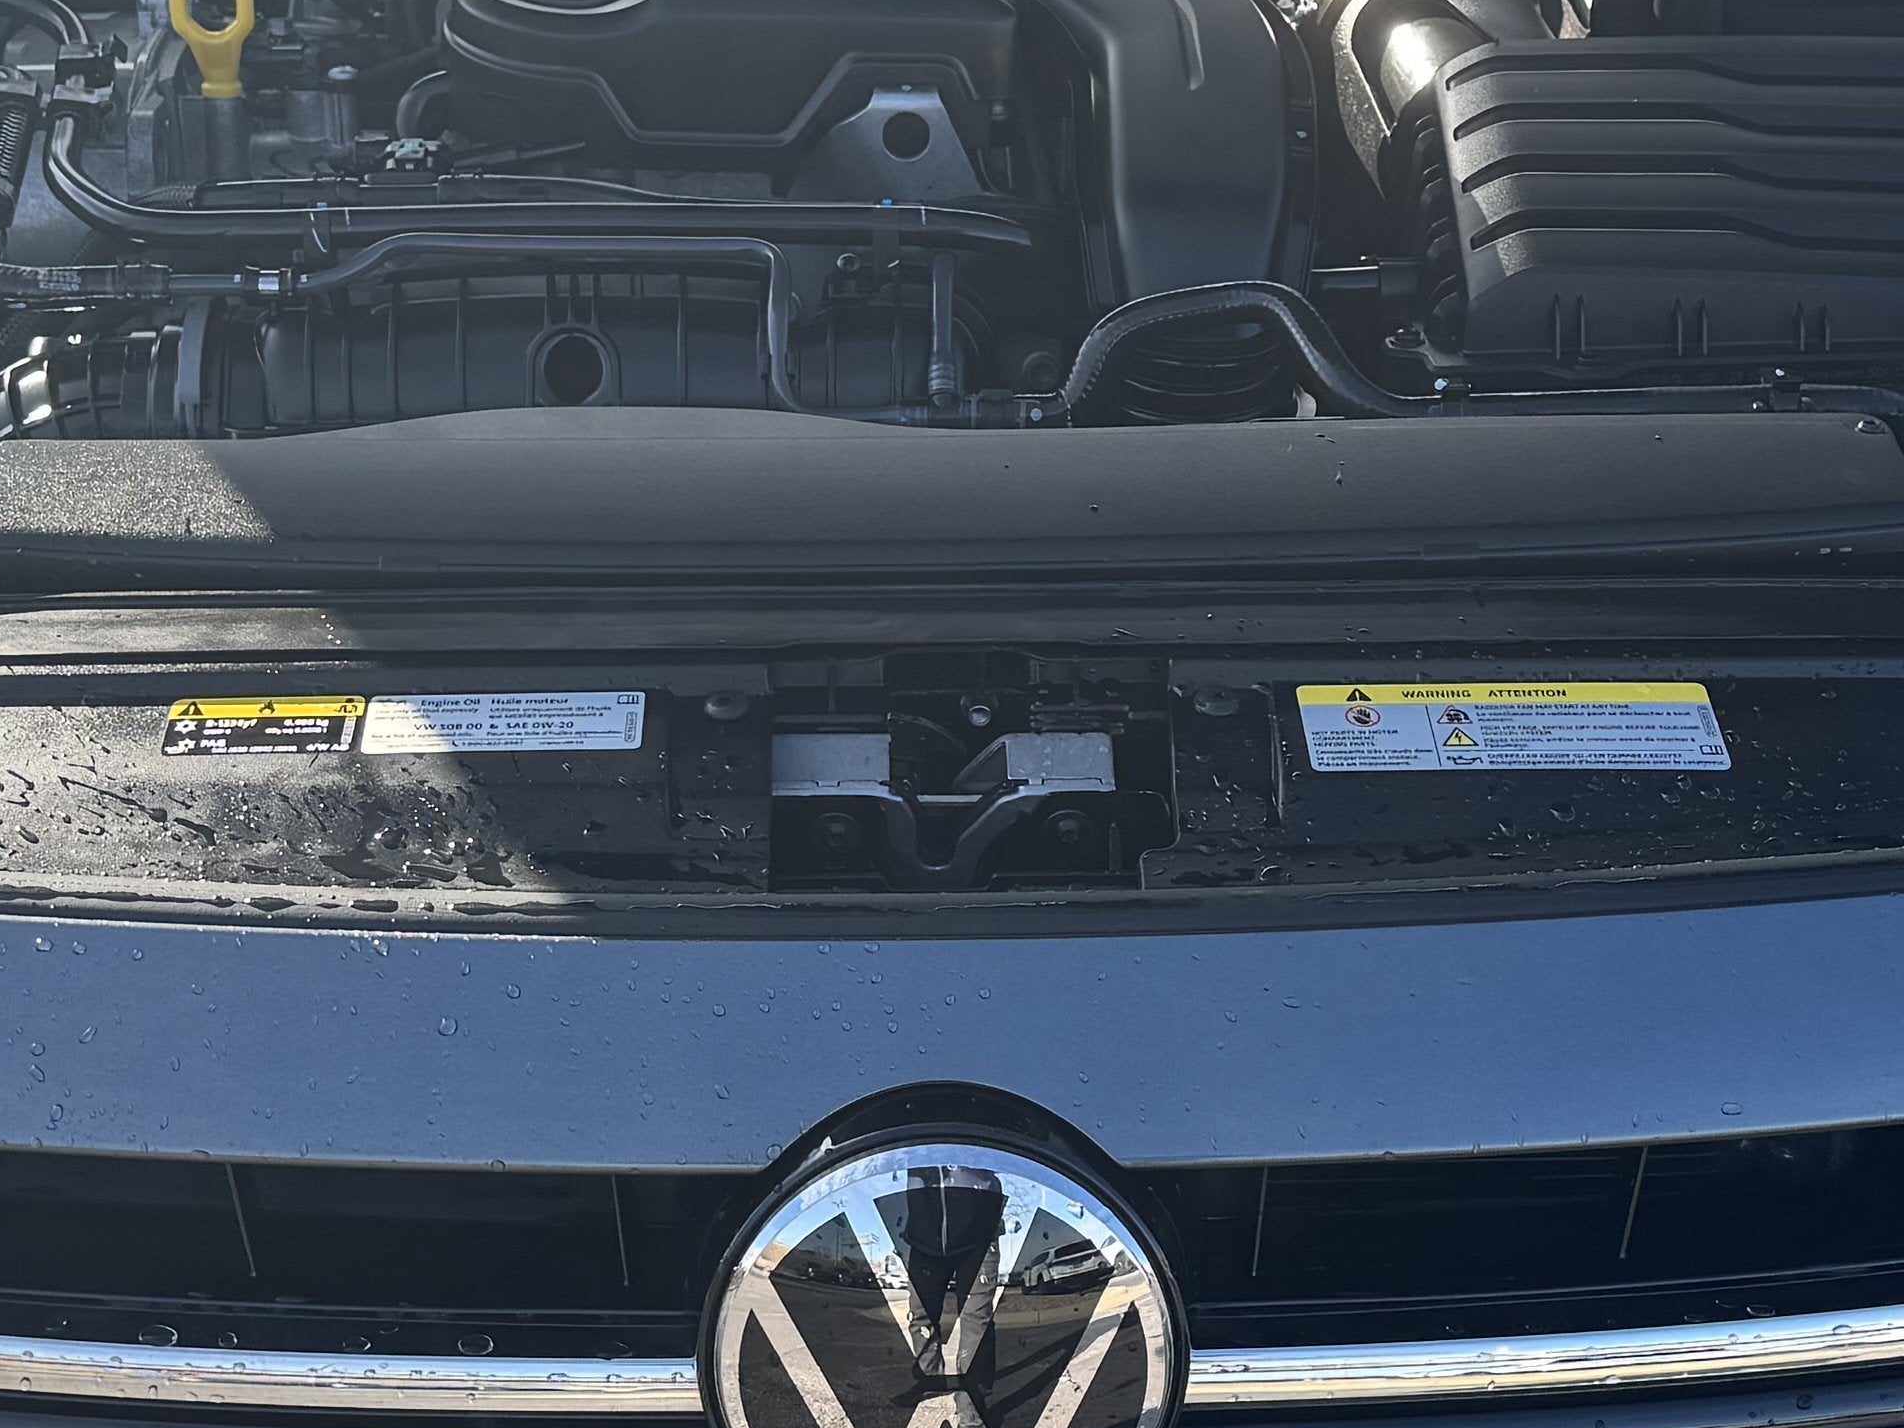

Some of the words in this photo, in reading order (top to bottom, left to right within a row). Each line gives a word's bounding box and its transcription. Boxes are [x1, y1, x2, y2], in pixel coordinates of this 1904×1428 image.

[1401, 689, 1472, 699] WARNING
[1488, 689, 1567, 698] ATTENTION
[421, 699, 461, 708] Engine
[463, 698, 481, 706] Oil
[414, 723, 437, 731] VW
